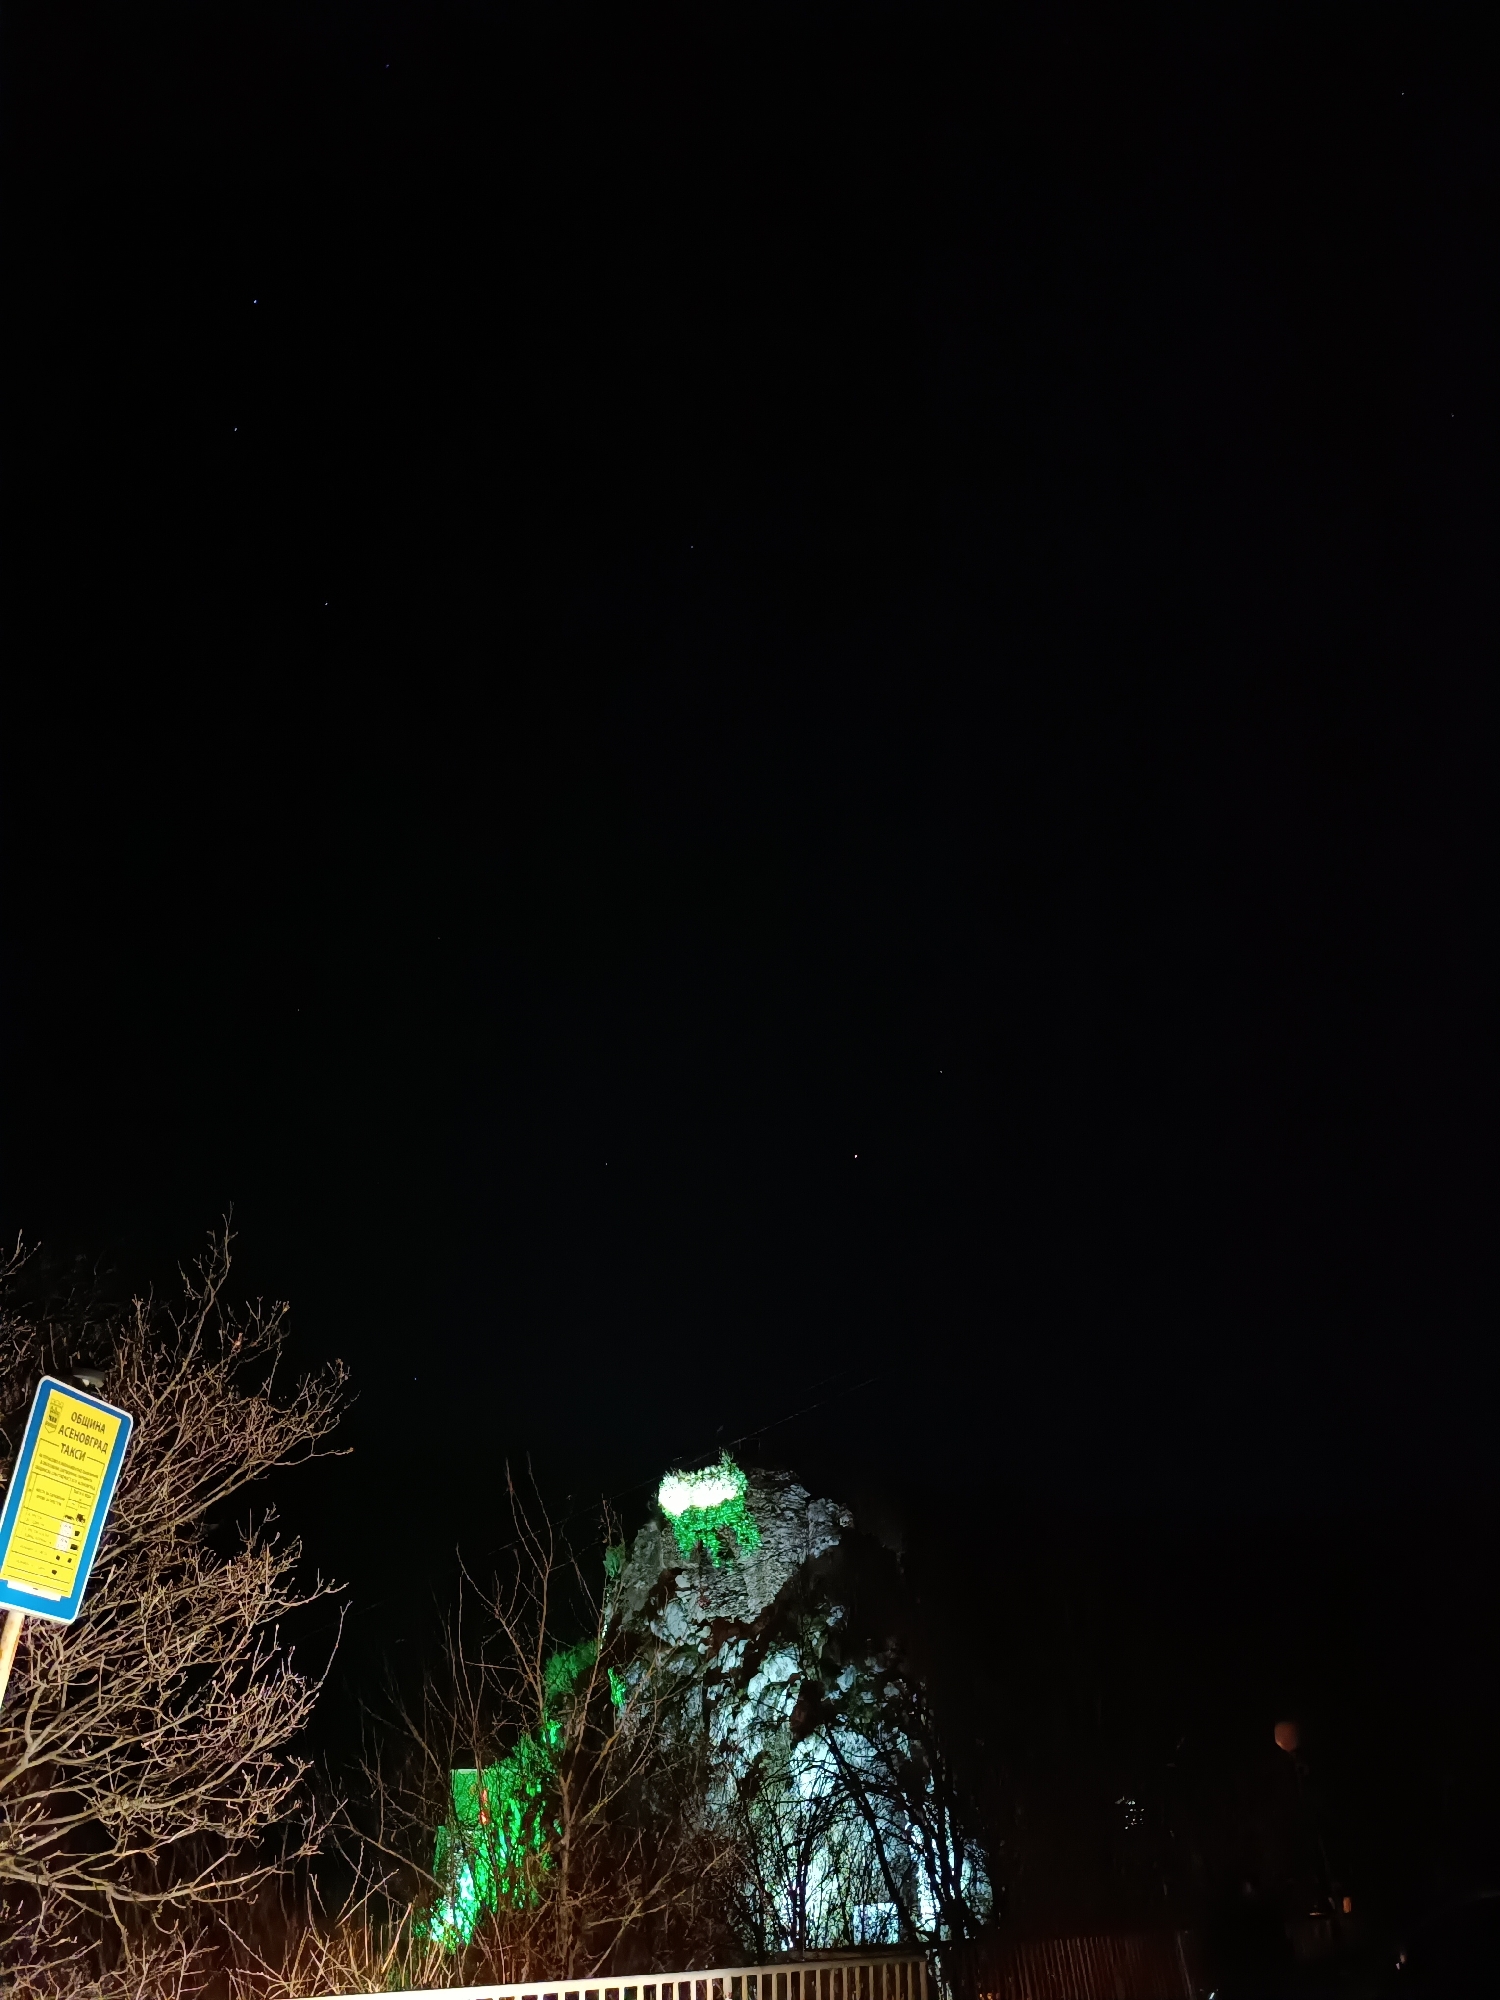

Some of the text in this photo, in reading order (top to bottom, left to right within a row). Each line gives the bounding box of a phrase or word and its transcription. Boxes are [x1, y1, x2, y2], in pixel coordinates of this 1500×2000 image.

[71, 1411, 106, 1434] ОБЩИНА
[58, 1424, 109, 1455] АСЕНОВГРАД
[60, 1443, 87, 1461] ТАКСИ
